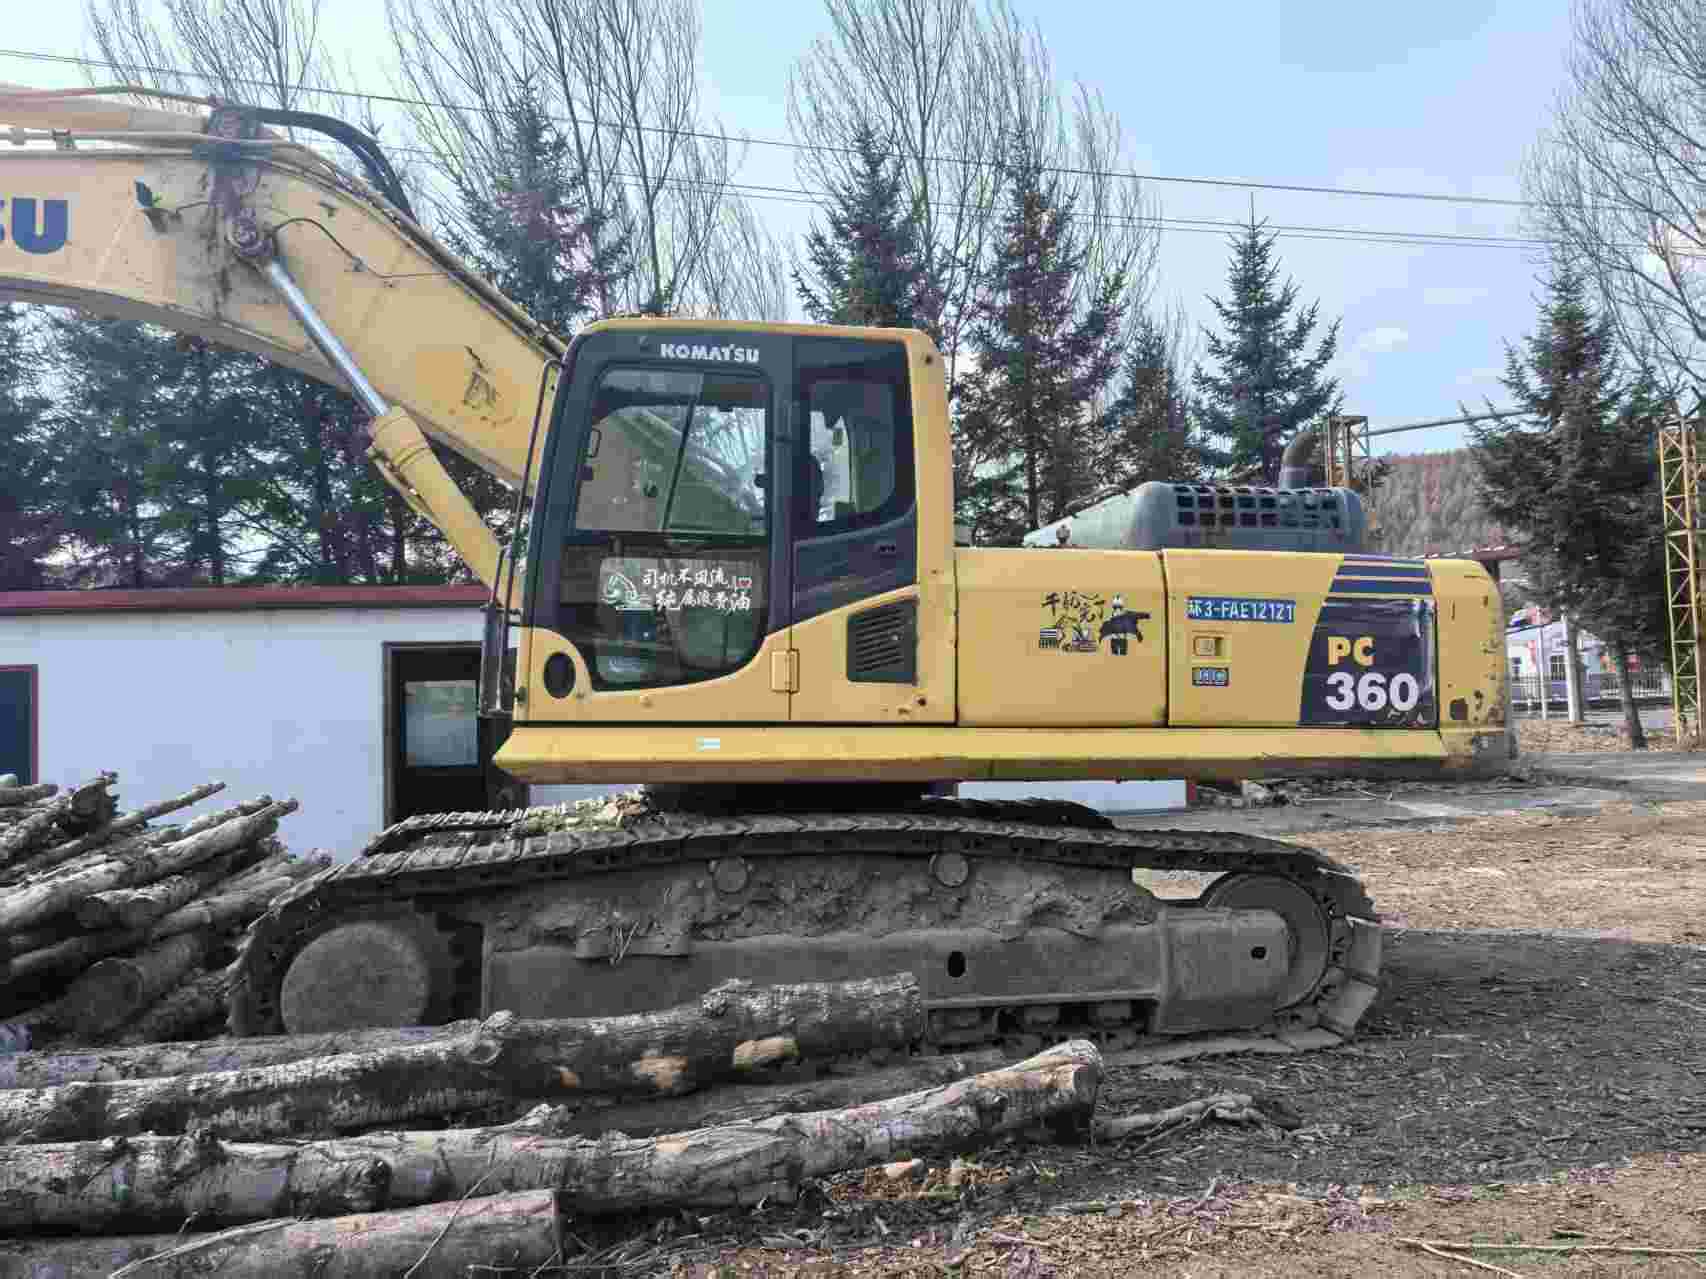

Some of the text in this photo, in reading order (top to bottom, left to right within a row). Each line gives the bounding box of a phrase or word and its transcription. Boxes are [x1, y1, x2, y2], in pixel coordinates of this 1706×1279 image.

[0, 197, 68, 254] U
[660, 343, 760, 362] KOMATSU
[1327, 636, 1376, 666] PC
[1326, 672, 1418, 711] 360
